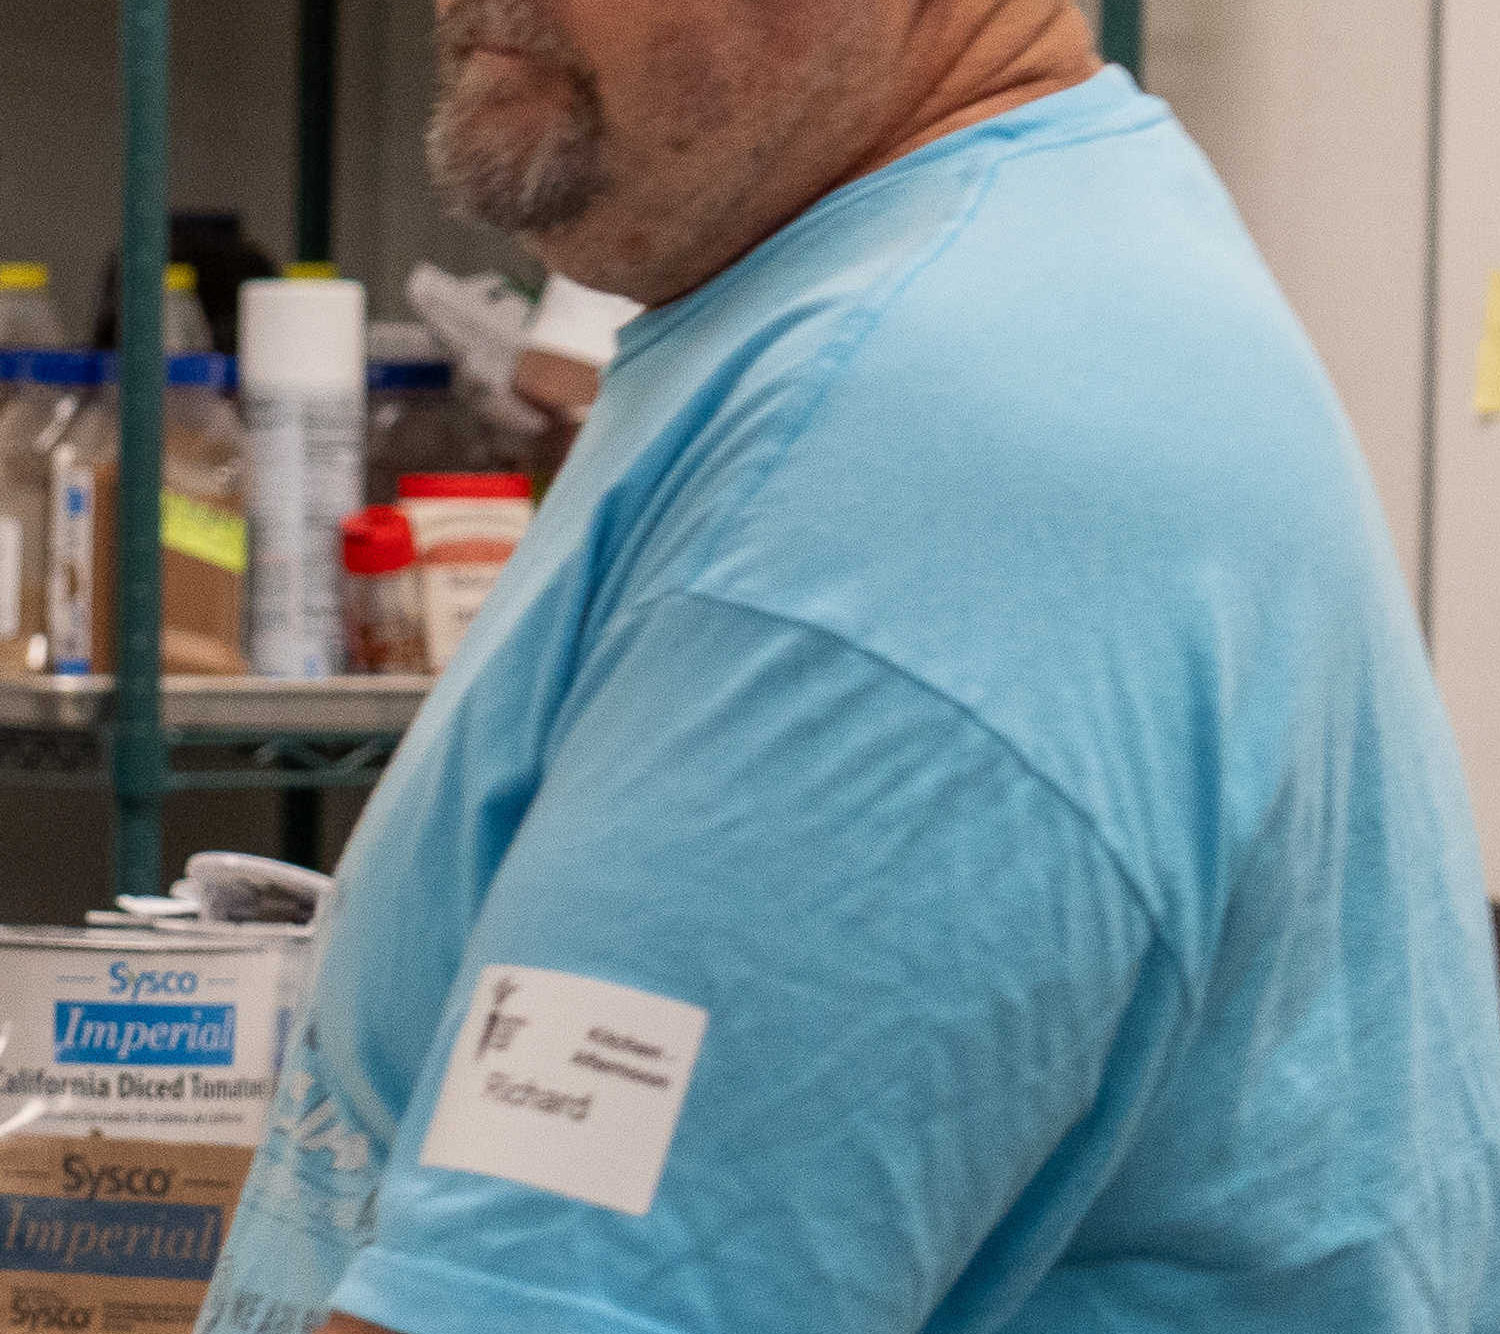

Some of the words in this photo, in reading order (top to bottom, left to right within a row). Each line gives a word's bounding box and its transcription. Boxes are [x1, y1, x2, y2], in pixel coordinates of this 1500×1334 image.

[108, 960, 199, 1001] Sysco
[59, 1004, 234, 1059] Imperial
[118, 1070, 184, 1099] Diced
[486, 1070, 592, 1121] Richard
[61, 1153, 173, 1200] Sysco
[3, 1200, 219, 1267] Imperial
